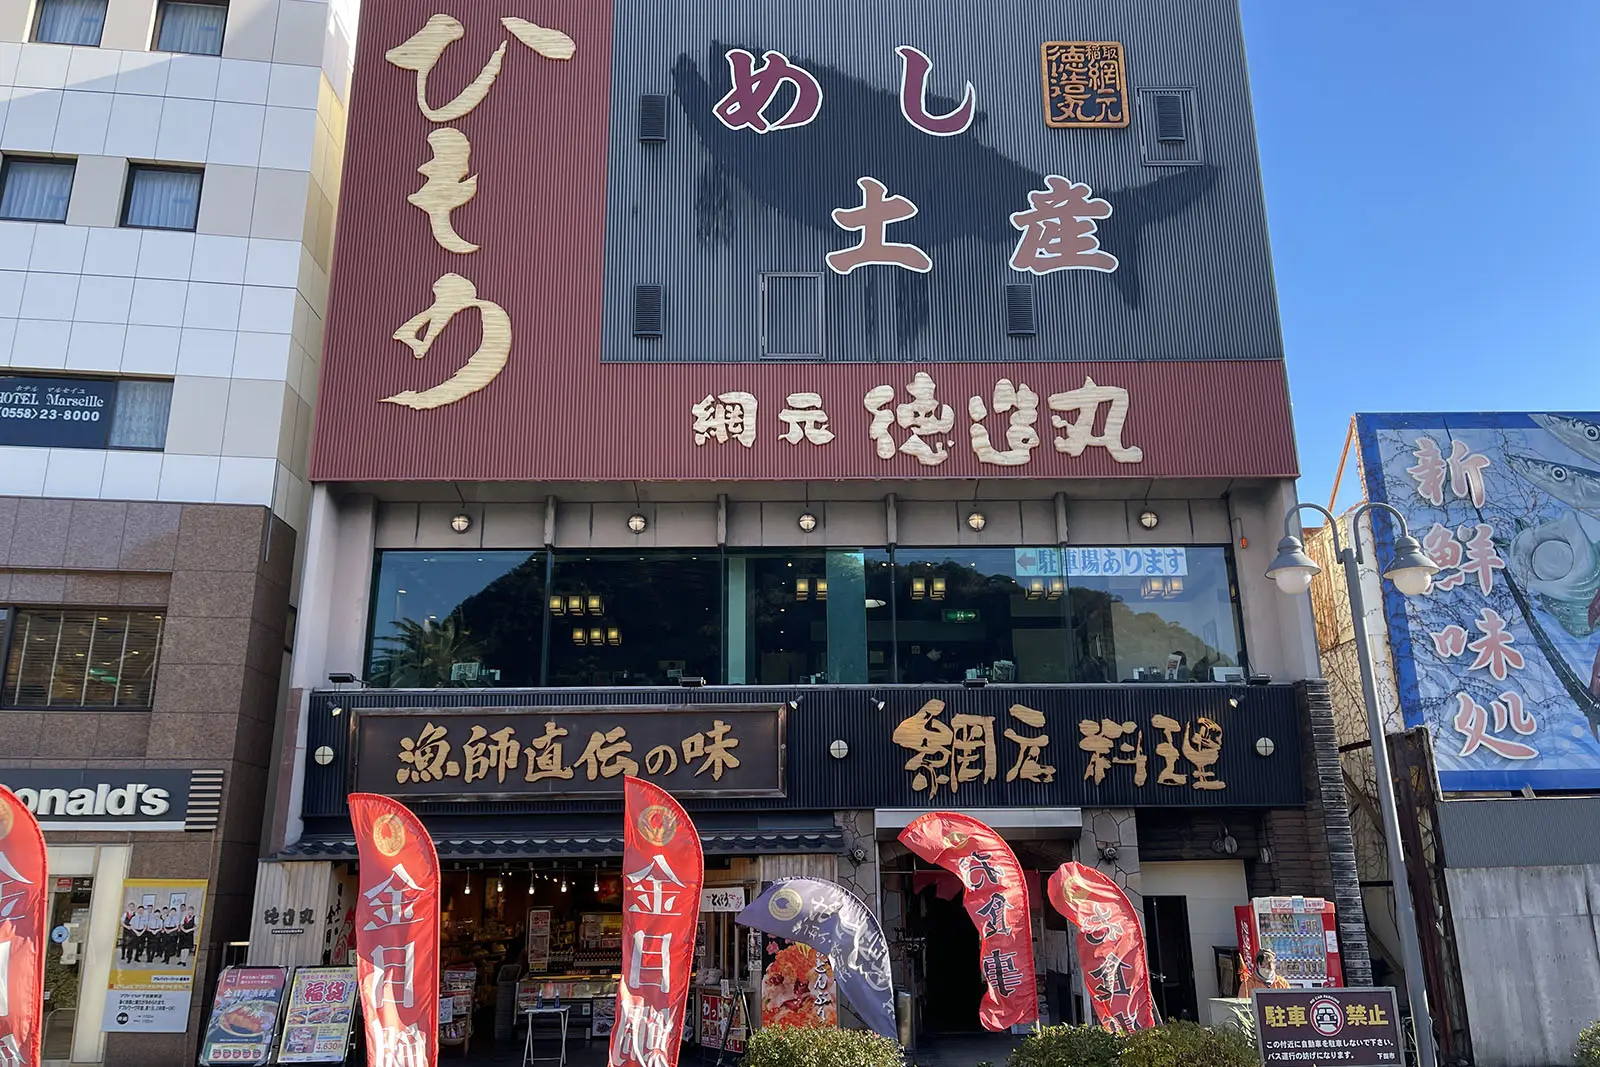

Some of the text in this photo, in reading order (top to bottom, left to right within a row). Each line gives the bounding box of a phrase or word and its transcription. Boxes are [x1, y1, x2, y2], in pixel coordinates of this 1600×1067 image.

[713, 45, 976, 137] めし
[377, 13, 577, 411] ひもの
[826, 175, 1119, 276] 土産
[45, 393, 104, 407] Marseille
[1407, 437, 1539, 760] 新鮮味処
[396, 720, 741, 784] 漁師直伝の味
[14, 783, 170, 816] onald's
[1264, 1004, 1389, 1027] 駐車 禁止
